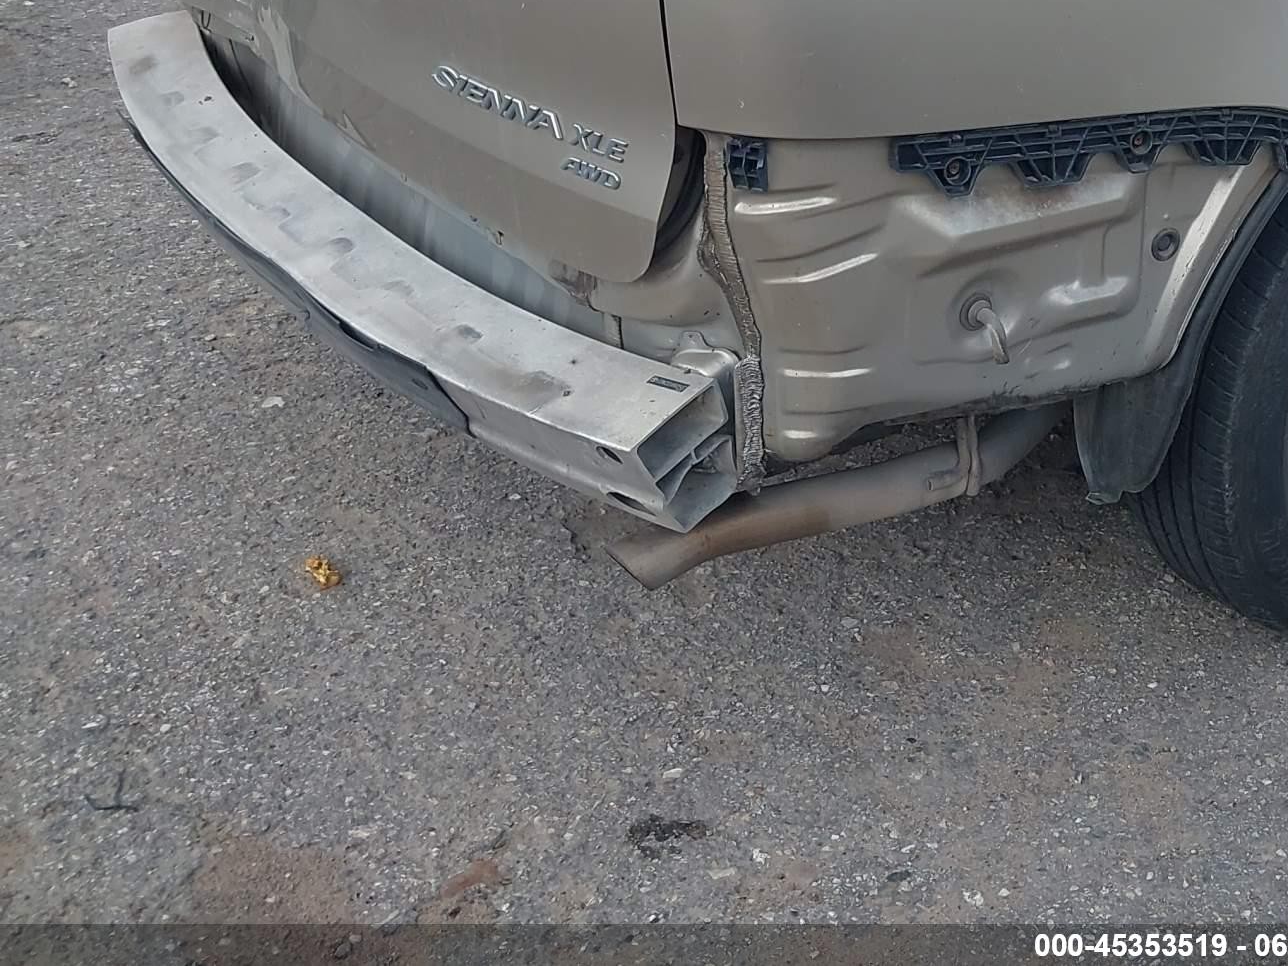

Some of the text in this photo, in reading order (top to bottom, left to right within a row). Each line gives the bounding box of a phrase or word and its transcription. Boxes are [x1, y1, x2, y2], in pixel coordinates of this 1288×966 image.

[432, 65, 629, 164] SIENNA XLE
[561, 156, 622, 190] AWD
